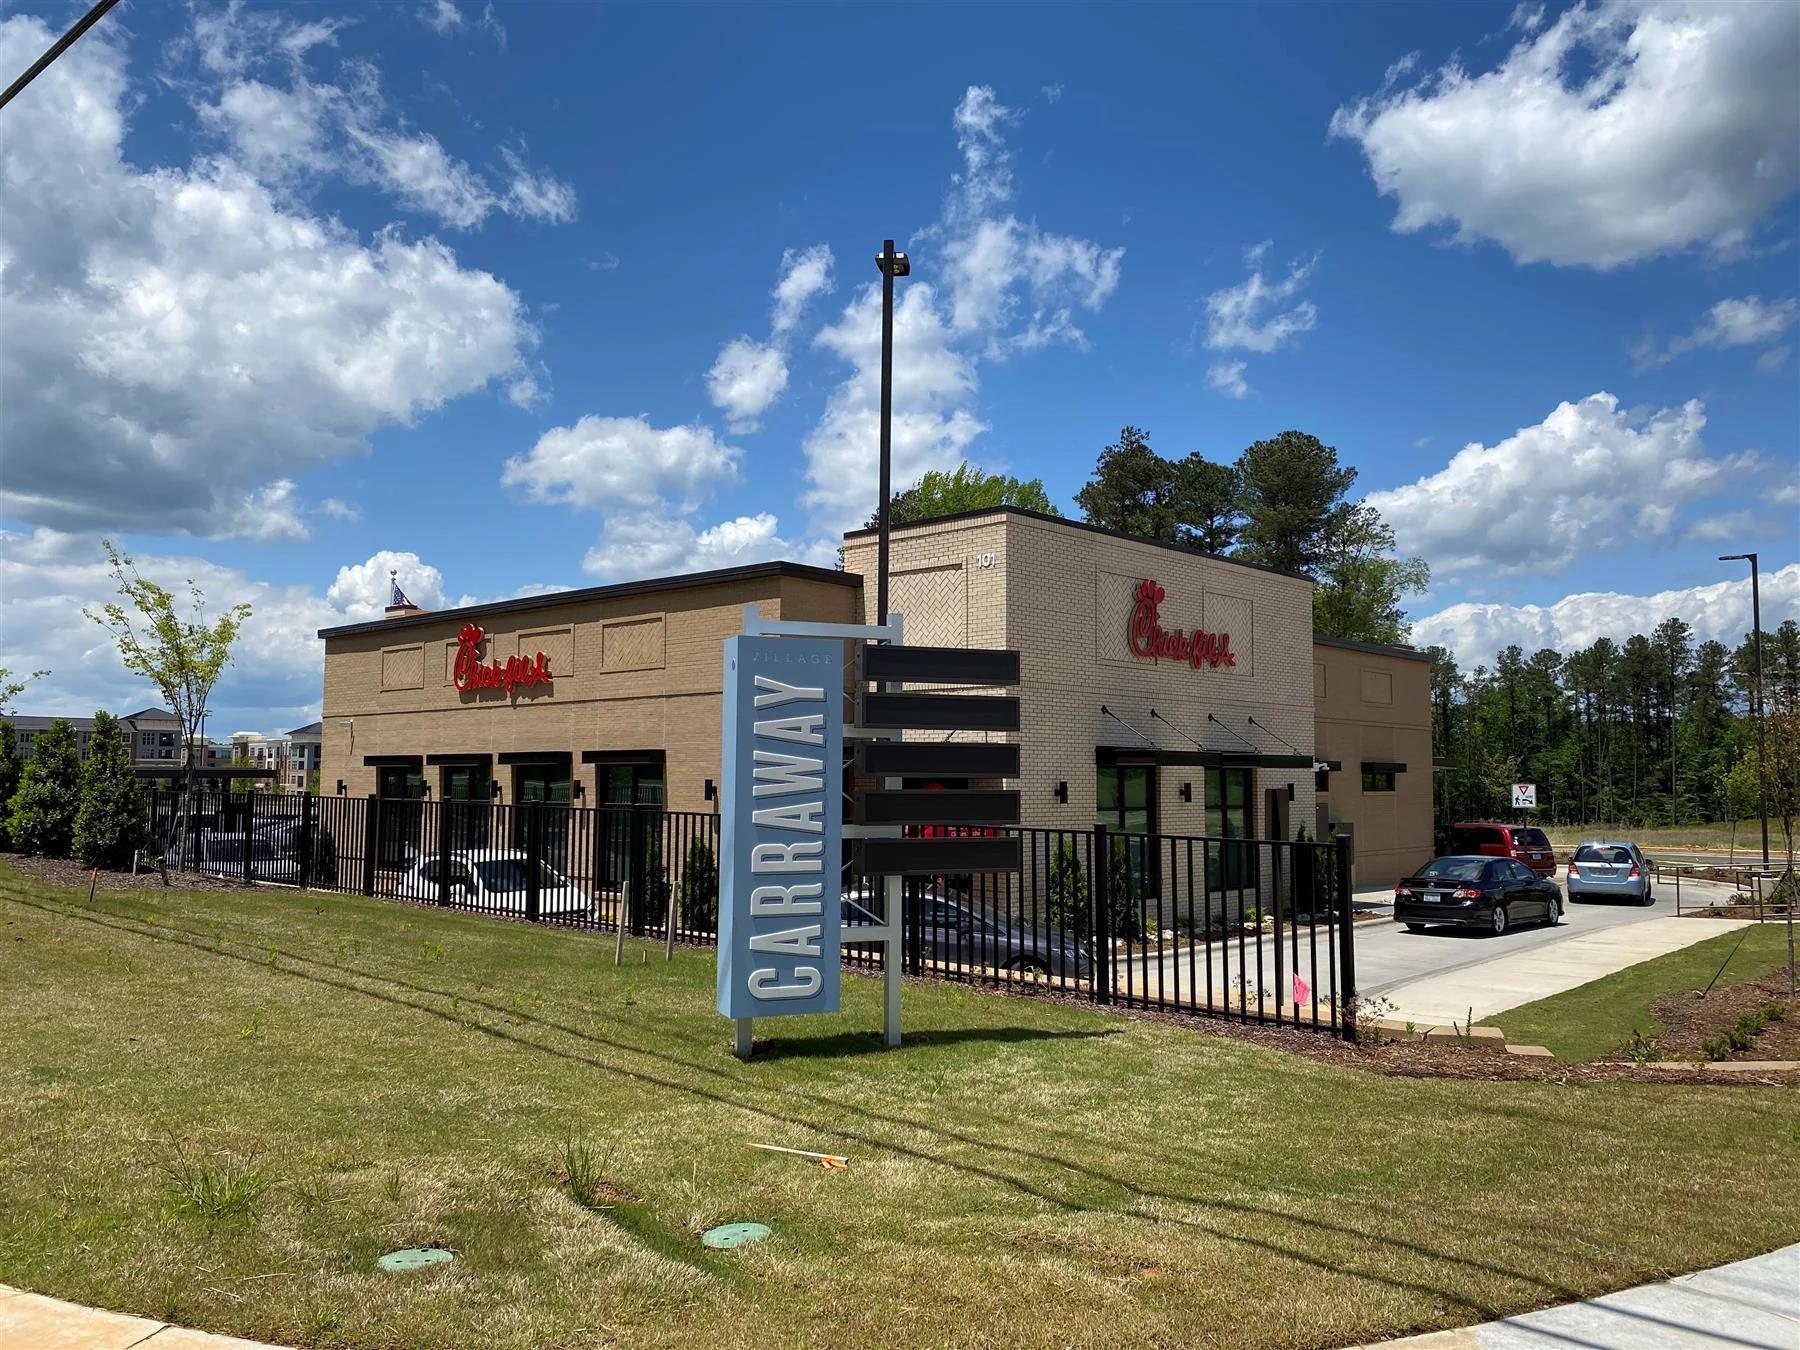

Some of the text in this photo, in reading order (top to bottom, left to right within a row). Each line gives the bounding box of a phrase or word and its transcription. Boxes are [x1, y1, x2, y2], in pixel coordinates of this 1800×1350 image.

[976, 552, 995, 568] 101
[453, 624, 553, 693] Chick-fil-A
[752, 652, 833, 664] VILLAGE
[1131, 580, 1236, 669] Chick-fil-A
[747, 674, 827, 1000] CARRAWAY
